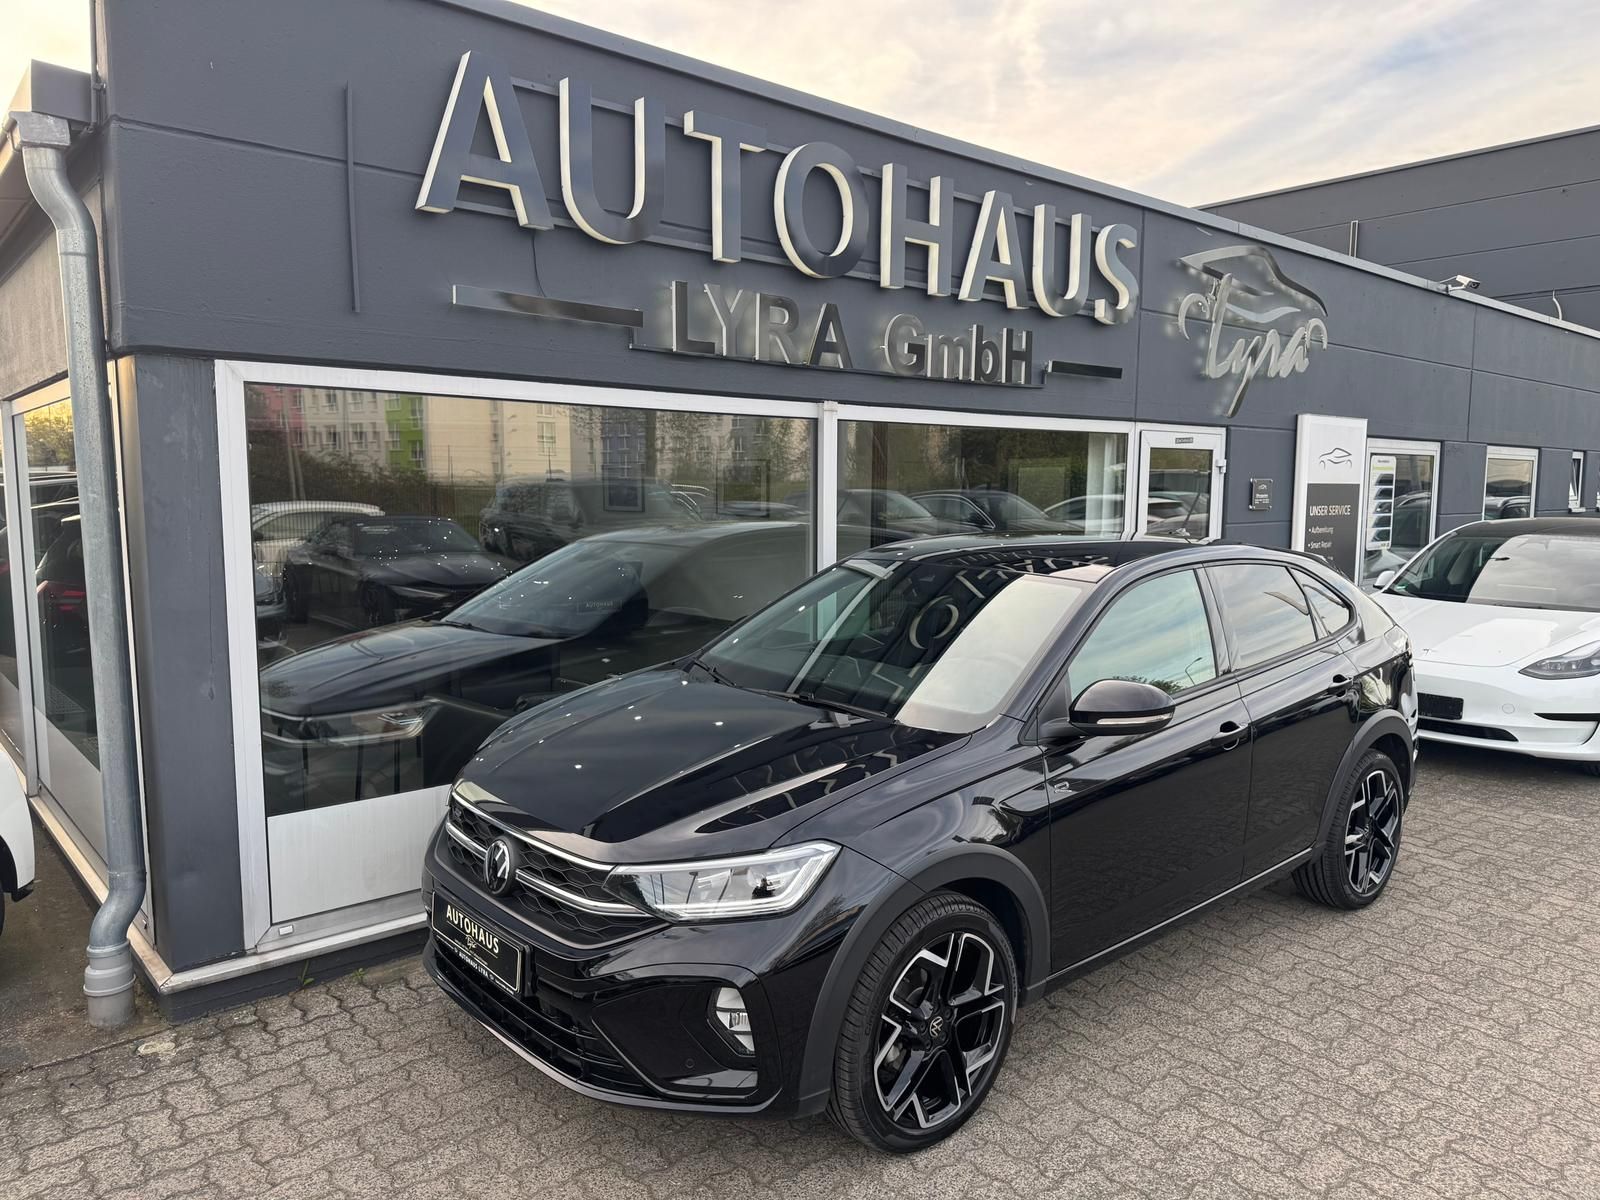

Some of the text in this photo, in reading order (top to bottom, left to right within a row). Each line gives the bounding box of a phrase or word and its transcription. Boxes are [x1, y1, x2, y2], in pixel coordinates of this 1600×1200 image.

[415, 50, 1139, 325] AUTOHAUS
[671, 279, 1033, 385] LYRA GmbH
[1309, 504, 1351, 516] UNSER SERVICE
[446, 904, 499, 954] AUTOHAUS
